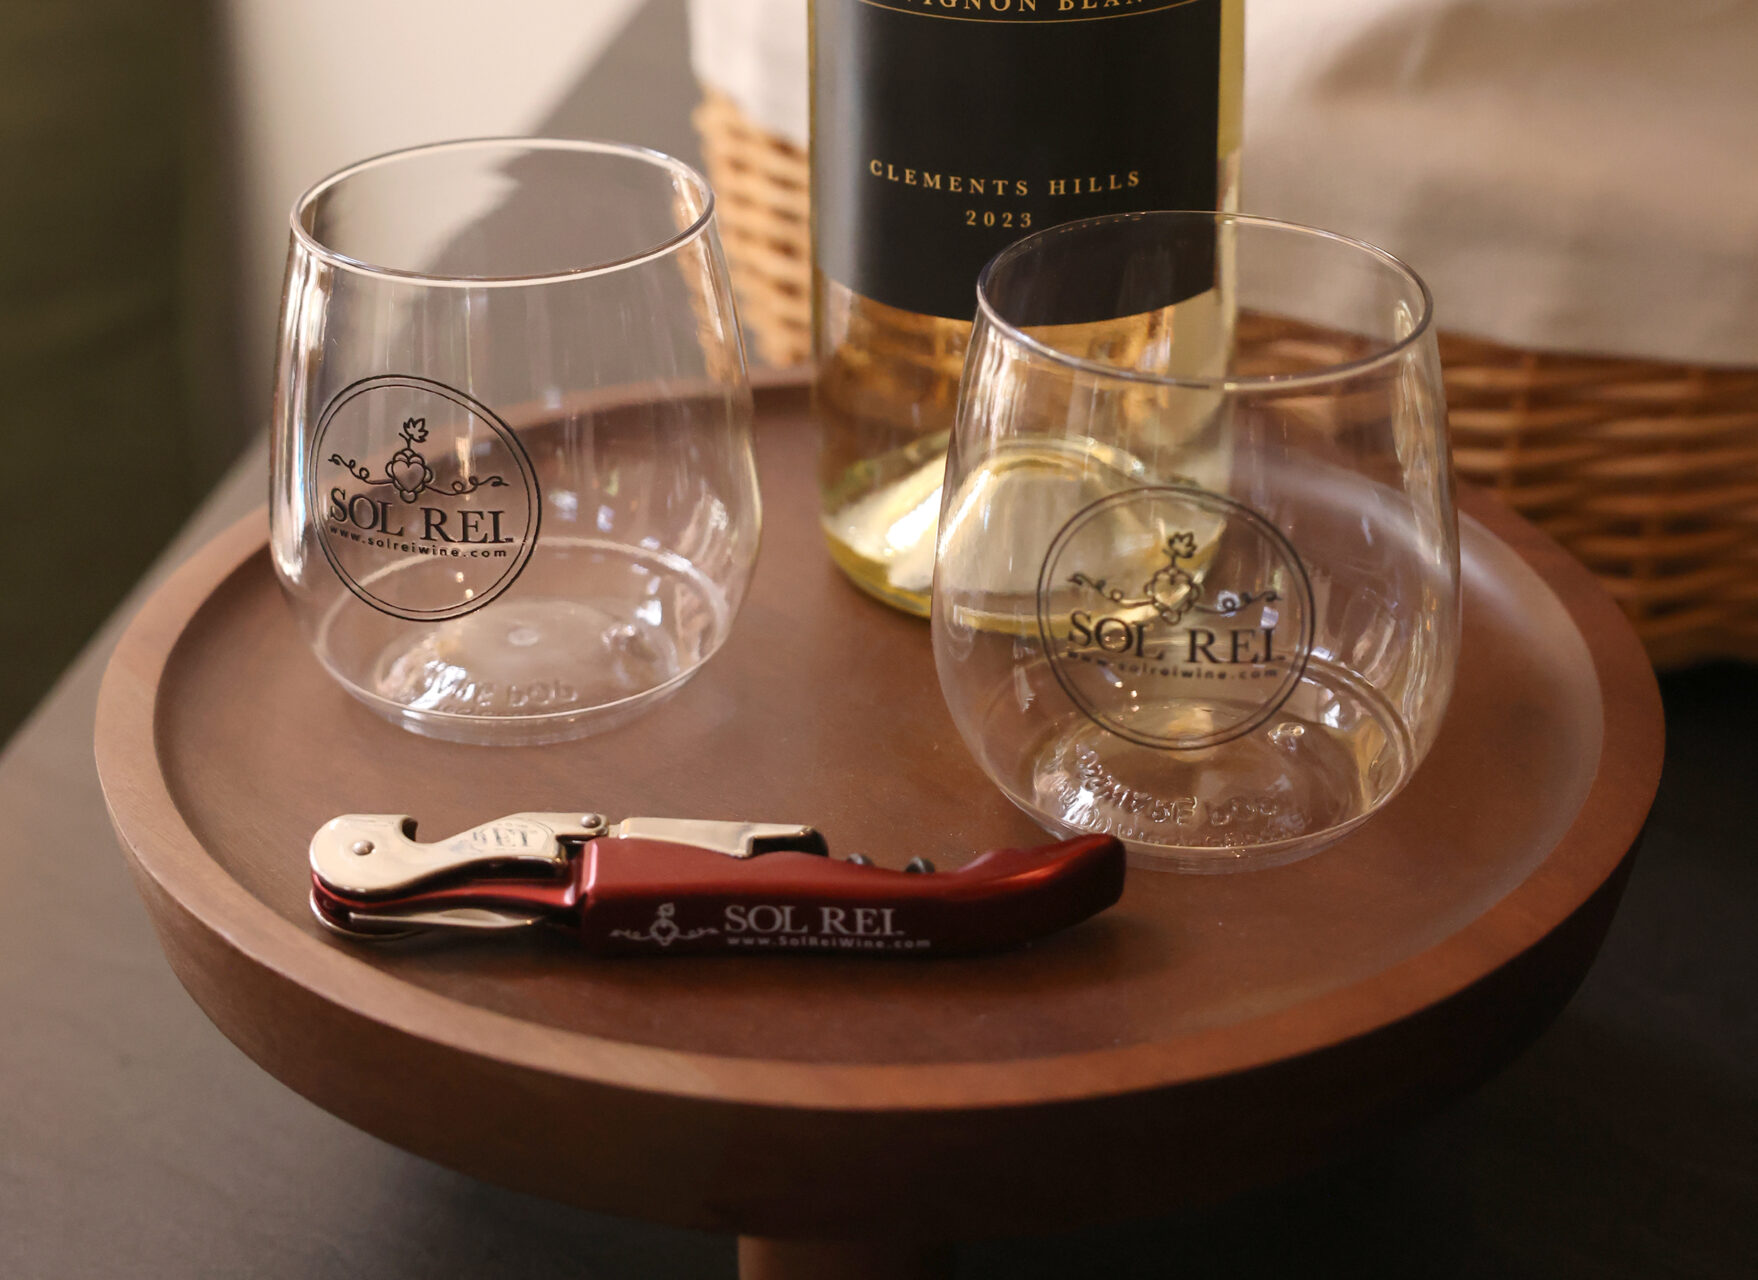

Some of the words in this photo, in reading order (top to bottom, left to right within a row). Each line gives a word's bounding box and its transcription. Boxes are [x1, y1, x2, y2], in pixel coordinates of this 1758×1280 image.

[869, 158, 1029, 196] CLEMENTS
[1049, 170, 1140, 196] HILLS
[965, 209, 1032, 228] 2023
[329, 487, 404, 538] SOL
[329, 525, 507, 558] www.solreiwine.com
[1067, 609, 1165, 660] SOL
[724, 904, 809, 934] SOL
